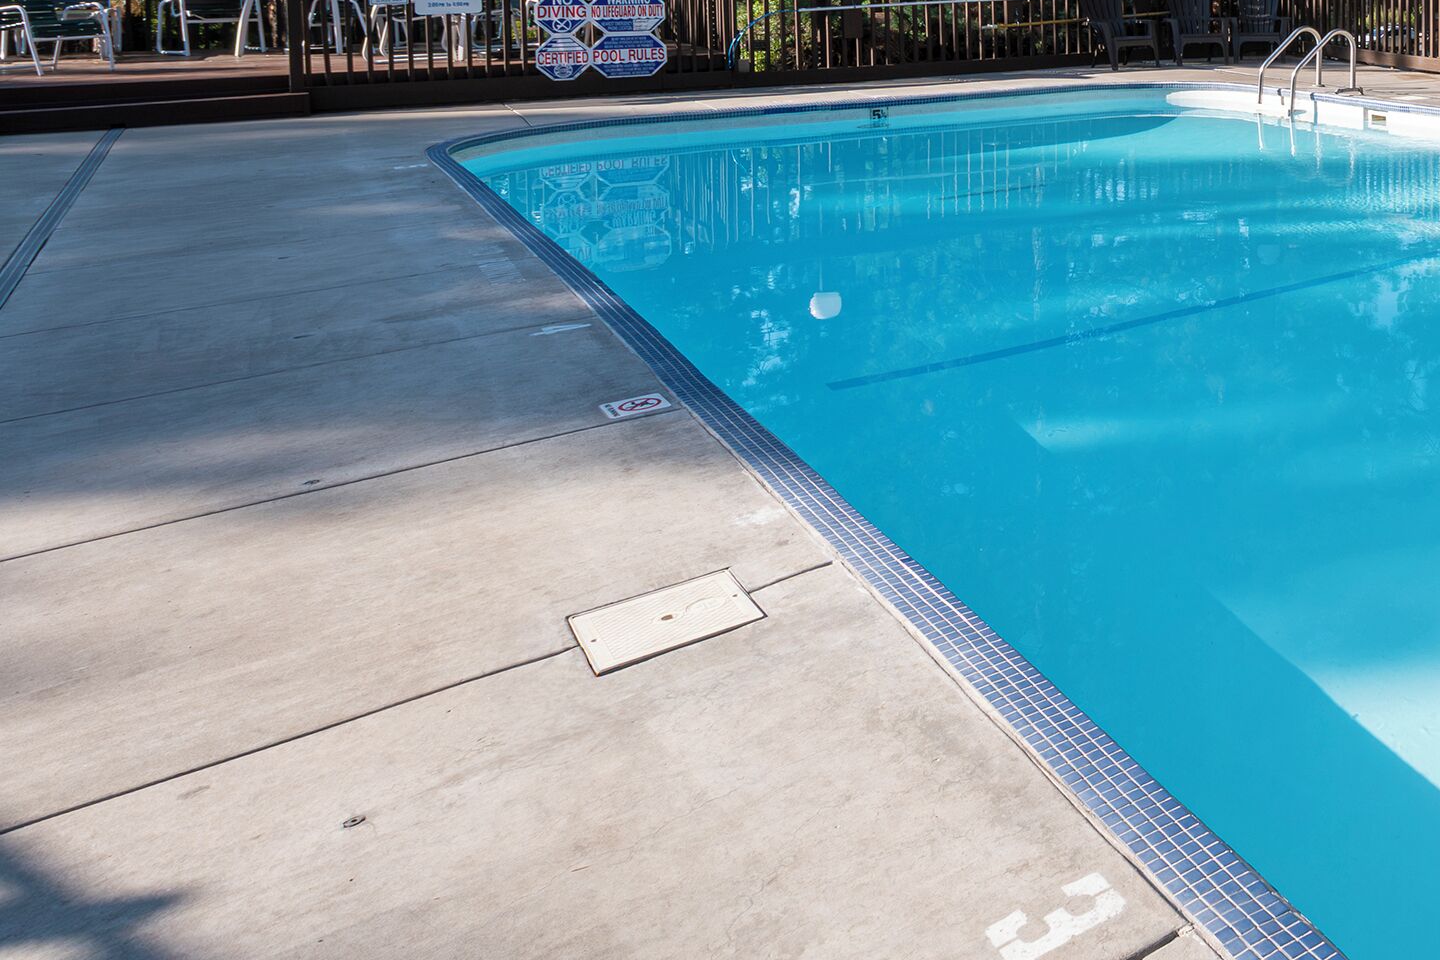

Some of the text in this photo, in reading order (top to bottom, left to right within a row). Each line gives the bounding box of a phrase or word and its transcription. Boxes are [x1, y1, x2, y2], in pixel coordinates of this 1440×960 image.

[537, 6, 586, 18] DIVING
[592, 5, 663, 17] NO LIFEGUARD ON DUTY
[538, 51, 588, 64] CERTIFIED
[593, 48, 665, 62] POOL RULES
[985, 872, 1126, 960] 3
